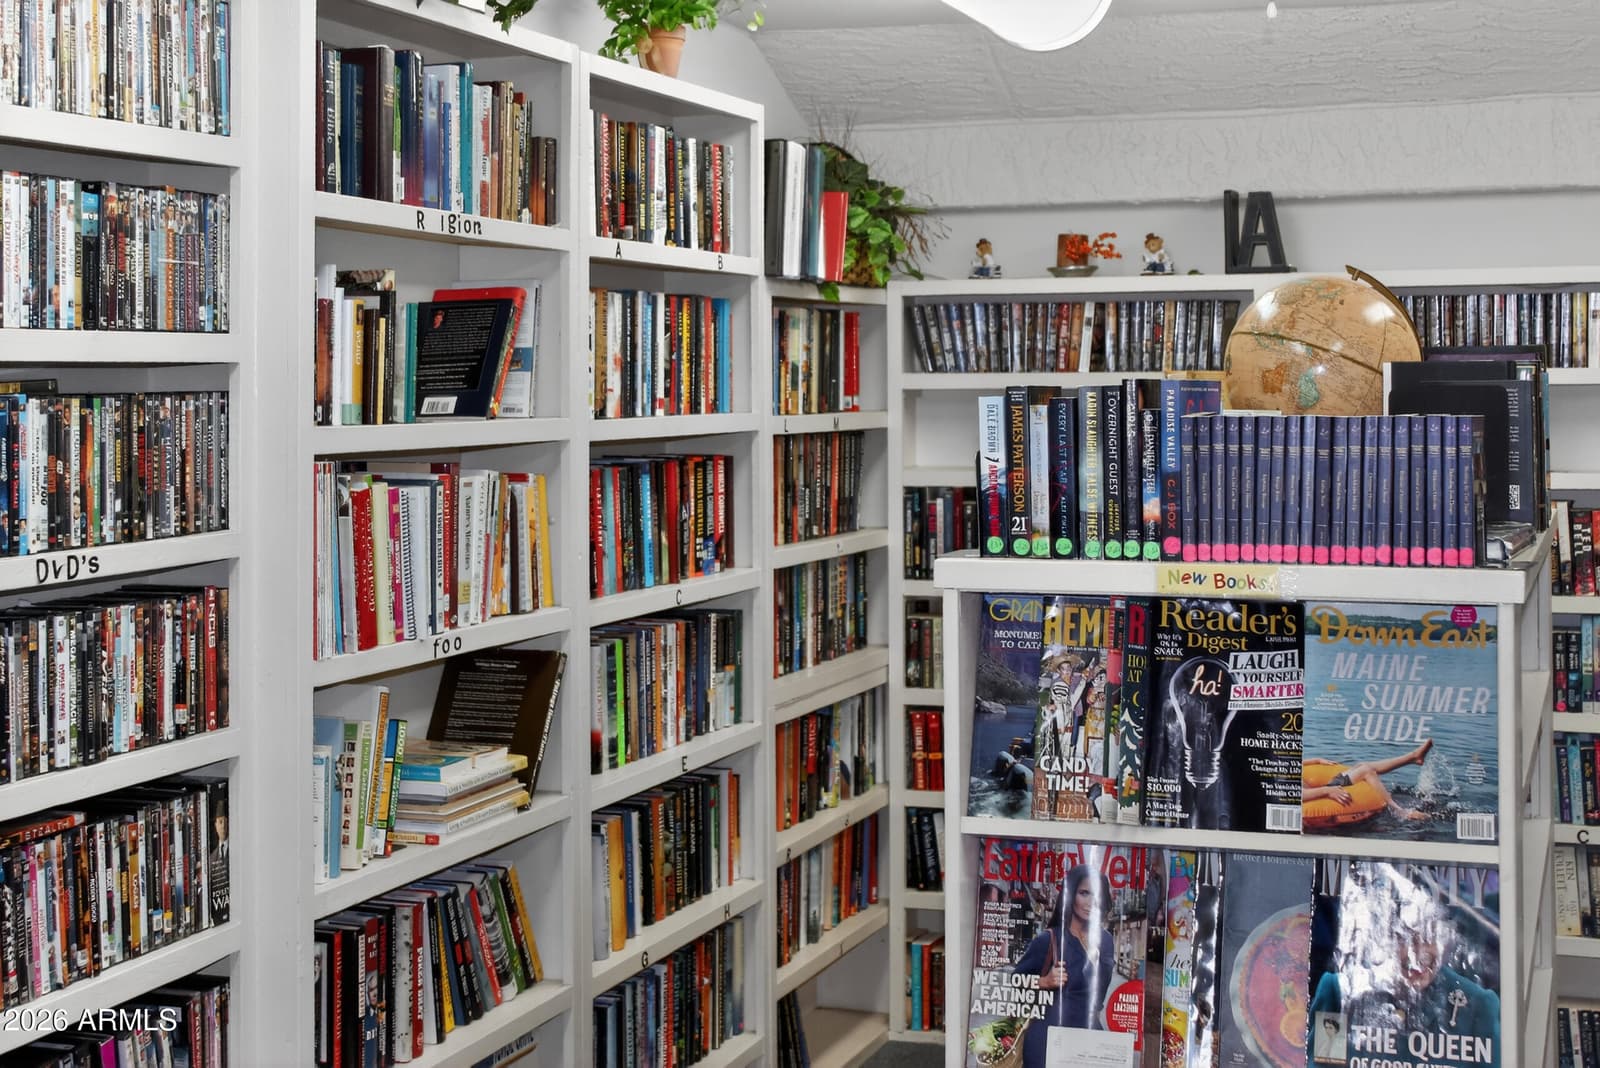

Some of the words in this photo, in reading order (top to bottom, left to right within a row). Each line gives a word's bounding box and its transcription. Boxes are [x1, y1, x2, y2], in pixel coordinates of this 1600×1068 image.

[616, 242, 622, 258] A
[1058, 403, 1066, 432] EVERY
[1167, 389, 1175, 432] PARADISE
[1010, 405, 1024, 442] JAMES
[1108, 398, 1119, 460] OVERNIGHT
[1086, 420, 1098, 468] SLAUGHTER
[1012, 444, 1025, 512] PATTERSON
[1087, 473, 1098, 498] FALSE
[1108, 463, 1119, 495] GUEST
[1573, 524, 1583, 556] BELL
[1581, 527, 1592, 552] TED
[1168, 570, 1206, 585] New
[676, 590, 682, 605] C
[1160, 600, 1297, 636] Reader's
[1311, 605, 1416, 647] Down
[1420, 610, 1495, 650] East
[1000, 640, 1014, 648] TO
[1154, 647, 1184, 657] SNACK
[1187, 632, 1248, 654] Digest
[1232, 652, 1297, 670] LAUGH
[1331, 652, 1428, 682] MAINE
[1189, 664, 1222, 696] ha!
[1242, 671, 1304, 683] YOURSELF
[1233, 684, 1304, 698] SMARTER
[1361, 684, 1491, 714] SUMMER
[1256, 731, 1302, 740] Sanity-Savin
[1344, 712, 1434, 742] GUIDE
[397, 724, 406, 755] 1000
[1240, 738, 1269, 748] HOME
[1272, 739, 1303, 750] HACKS
[682, 756, 688, 772] E
[1040, 756, 1093, 774] CANDY
[1046, 774, 1090, 793] TIME!
[1147, 783, 1181, 793] $10,000
[24, 820, 70, 840] STEALTH
[1577, 830, 1589, 844] C
[1565, 860, 1575, 881] KEN
[212, 898, 231, 912] WA
[642, 952, 648, 968] G
[973, 970, 997, 986] WE
[1000, 972, 1040, 990] LOVE
[979, 986, 1035, 1003] EATING
[1038, 990, 1054, 1006] IN
[971, 1000, 1046, 1020] AMERICA!
[1351, 1026, 1397, 1053] THE
[1408, 1031, 1492, 1063] QUEEN
